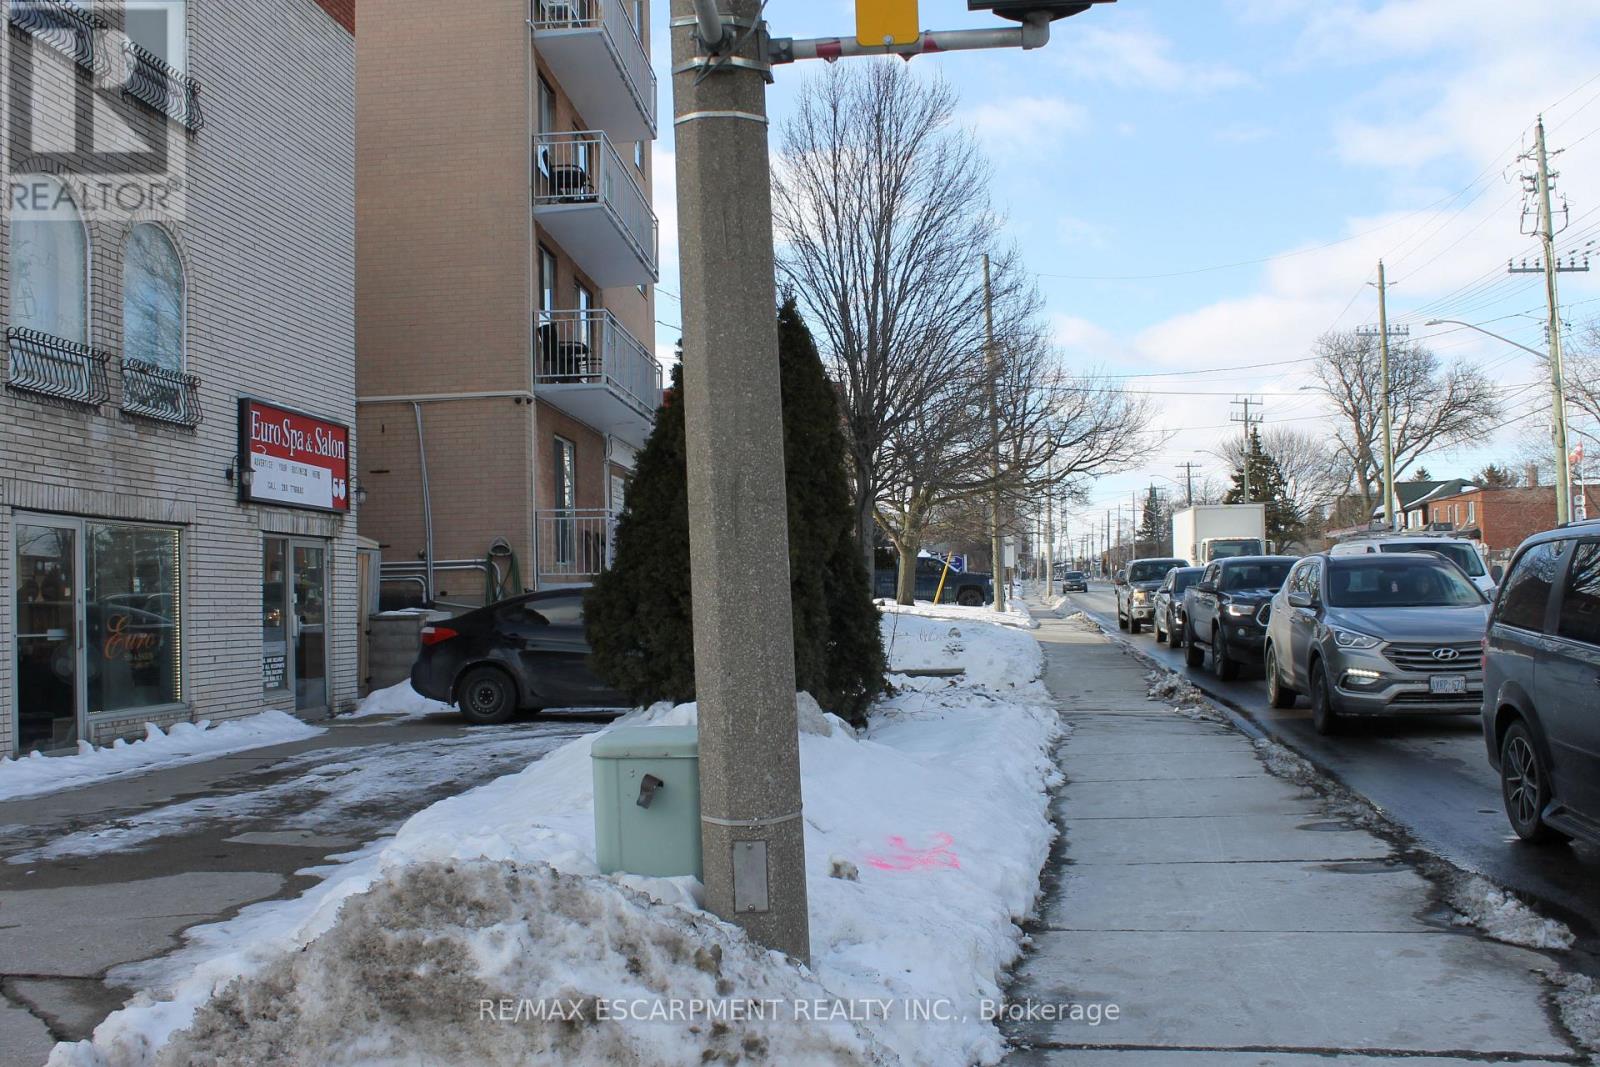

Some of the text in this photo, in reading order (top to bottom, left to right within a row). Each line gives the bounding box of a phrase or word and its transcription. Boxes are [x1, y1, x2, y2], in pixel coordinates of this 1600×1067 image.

[251, 410, 345, 460] Euro Spa & Salon
